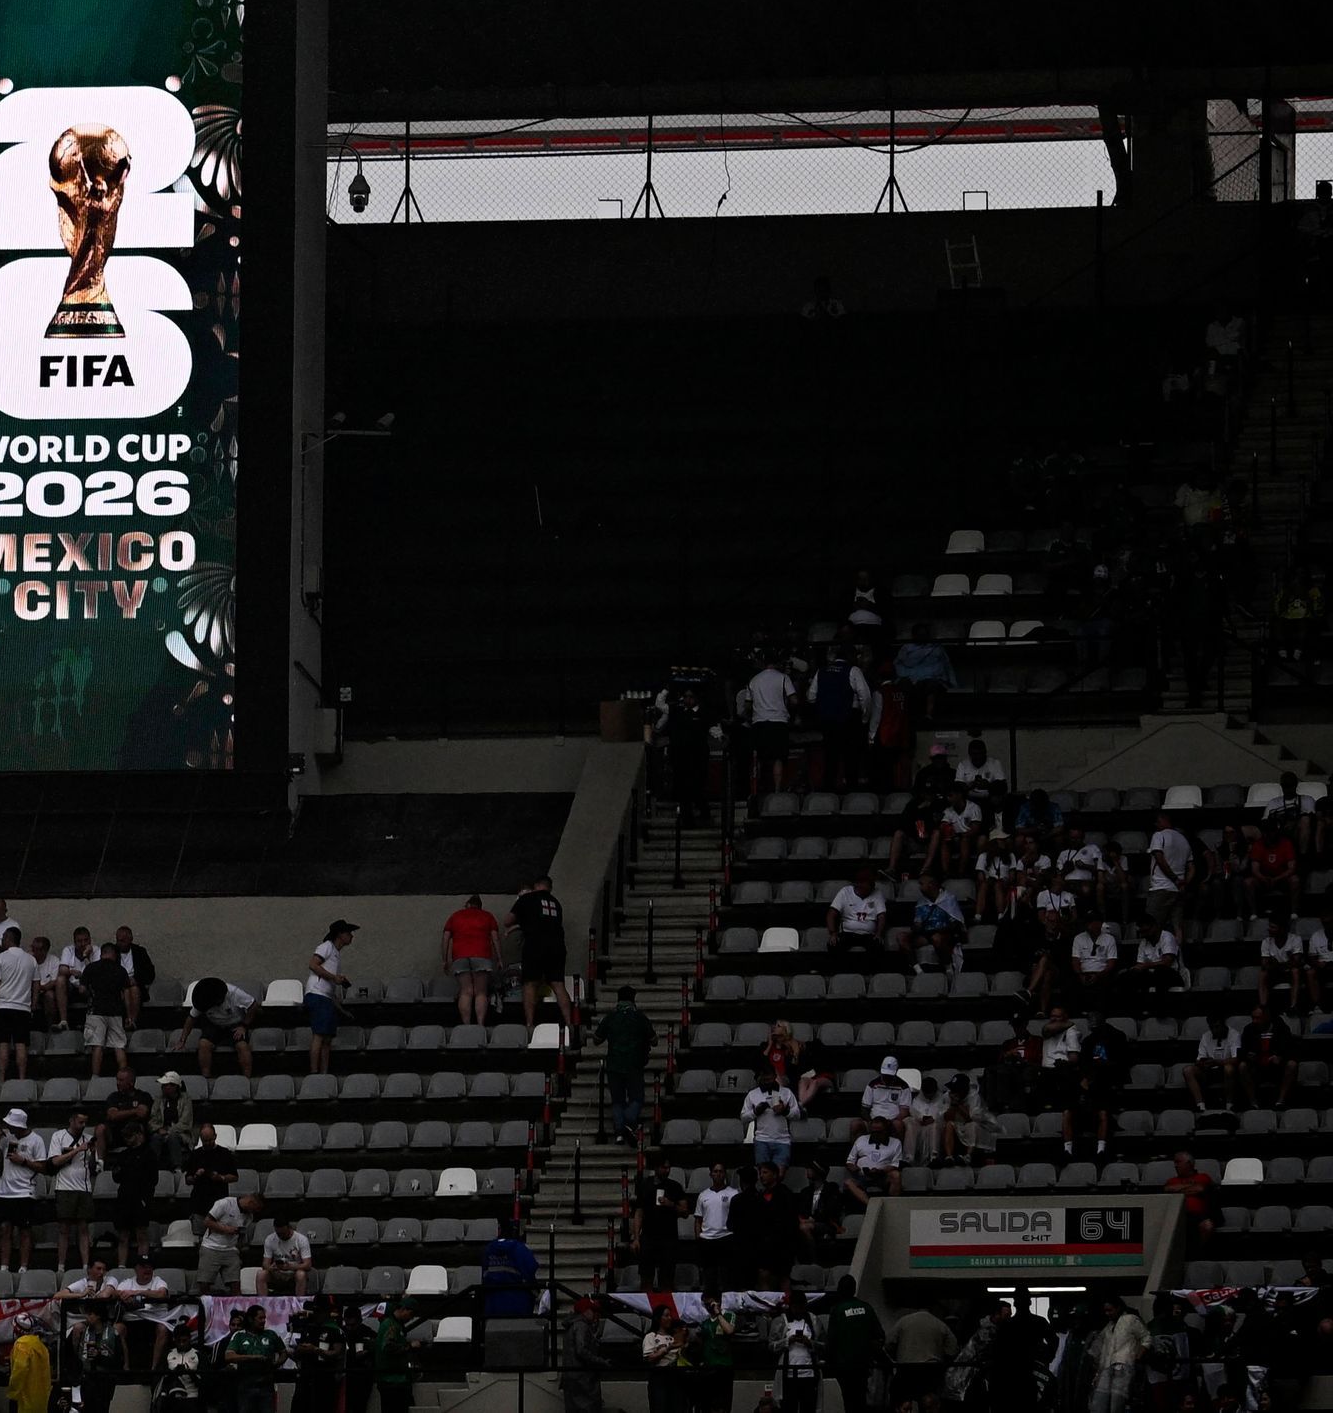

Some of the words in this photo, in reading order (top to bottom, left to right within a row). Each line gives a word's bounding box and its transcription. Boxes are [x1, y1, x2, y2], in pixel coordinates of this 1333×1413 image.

[40, 355, 135, 387] FIFA
[117, 434, 191, 463] CUP
[14, 580, 148, 621] CITY
[939, 1211, 1052, 1233] SALIDA
[1080, 1210, 1131, 1241] 64
[1021, 1234, 1051, 1242] EXIT
